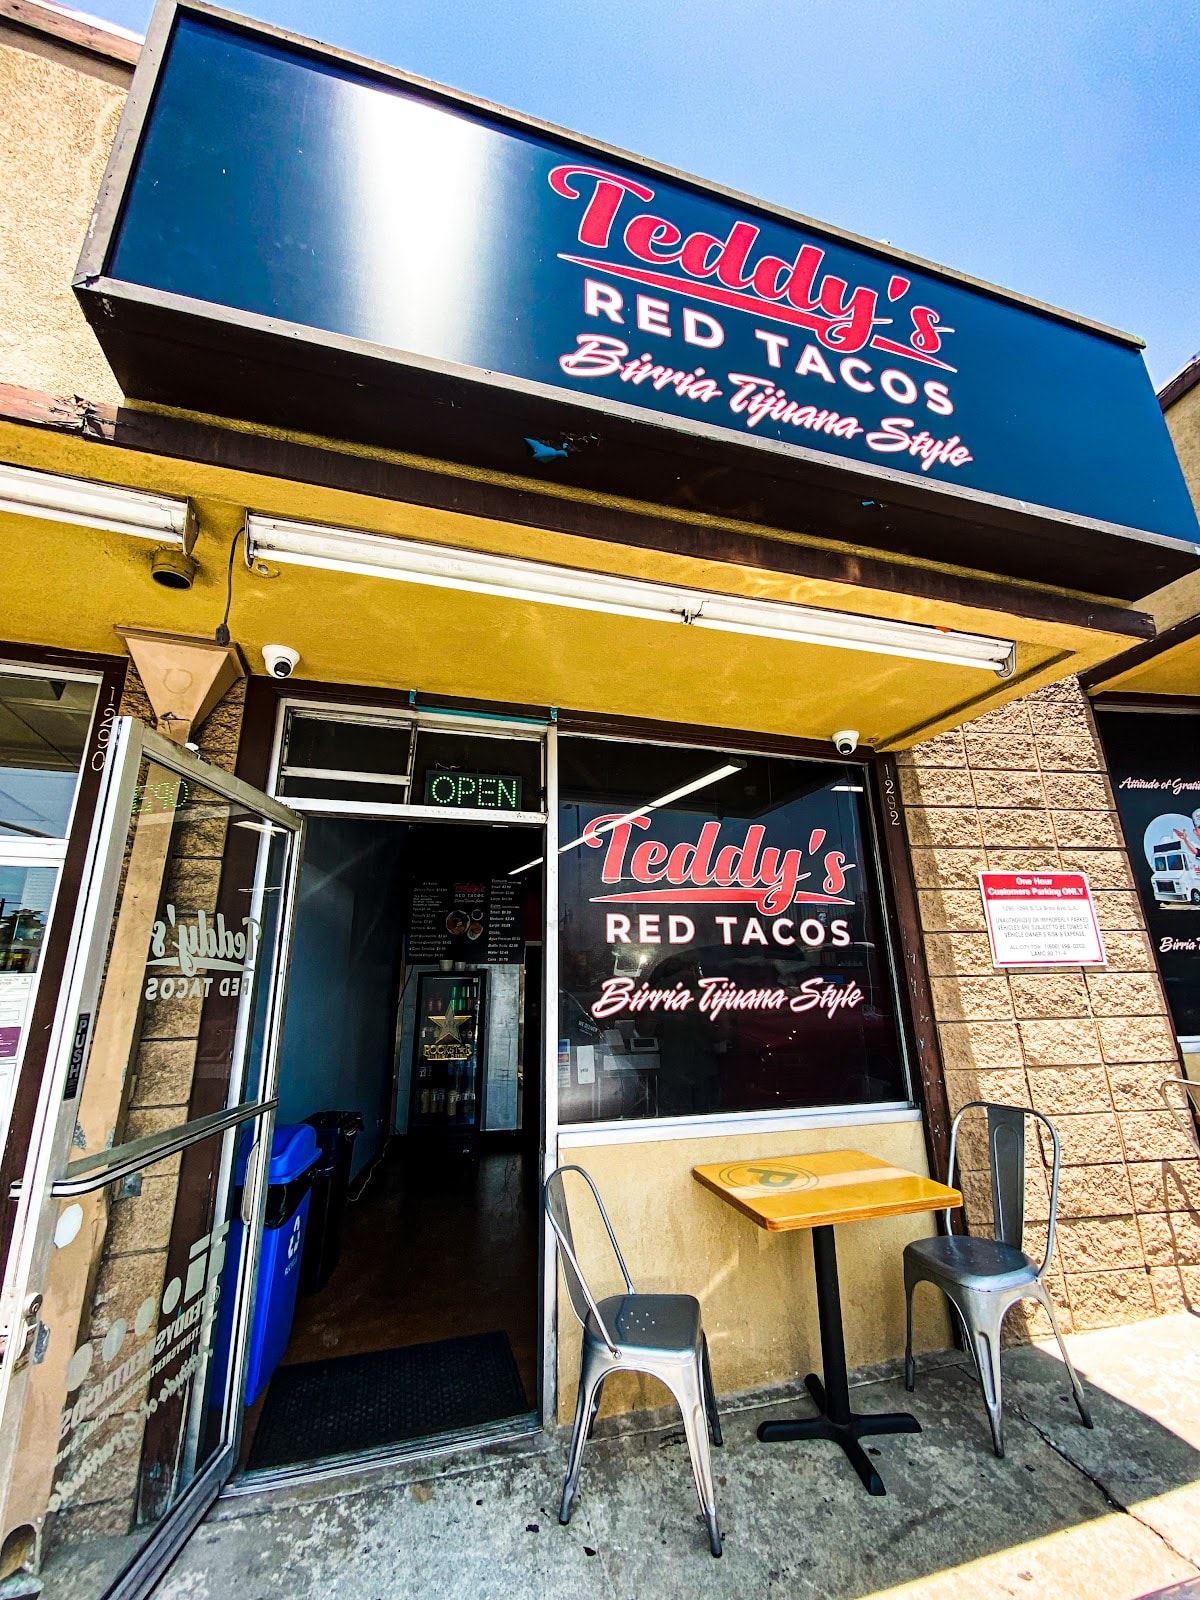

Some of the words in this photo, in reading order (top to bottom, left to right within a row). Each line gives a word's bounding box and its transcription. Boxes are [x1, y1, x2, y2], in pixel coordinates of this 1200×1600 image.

[549, 165, 955, 353] Teddy's
[584, 278, 725, 349] RED
[754, 327, 956, 417] TACOS
[558, 333, 723, 402] Birria
[727, 371, 864, 440] Tijuana
[865, 416, 973, 472] Style
[91, 686, 116, 772] 1290
[431, 775, 517, 808] OPEN
[884, 763, 900, 826] 1292
[1118, 776, 1160, 790] Attitude
[1161, 778, 1172, 790] of
[583, 813, 856, 916] Teddy's
[1015, 877, 1032, 885] One
[1033, 877, 1053, 885] Hour
[987, 887, 1031, 896] Customers
[1031, 887, 1062, 898] Parking
[1061, 887, 1084, 896] ONLY
[605, 912, 696, 944] RED
[715, 916, 851, 947] TACOS
[1159, 936, 1197, 953] Birria
[591, 976, 694, 1019] Birria
[697, 977, 788, 1022] Tijuana
[789, 977, 865, 1020] Style
[69, 1020, 87, 1079] PUSH
